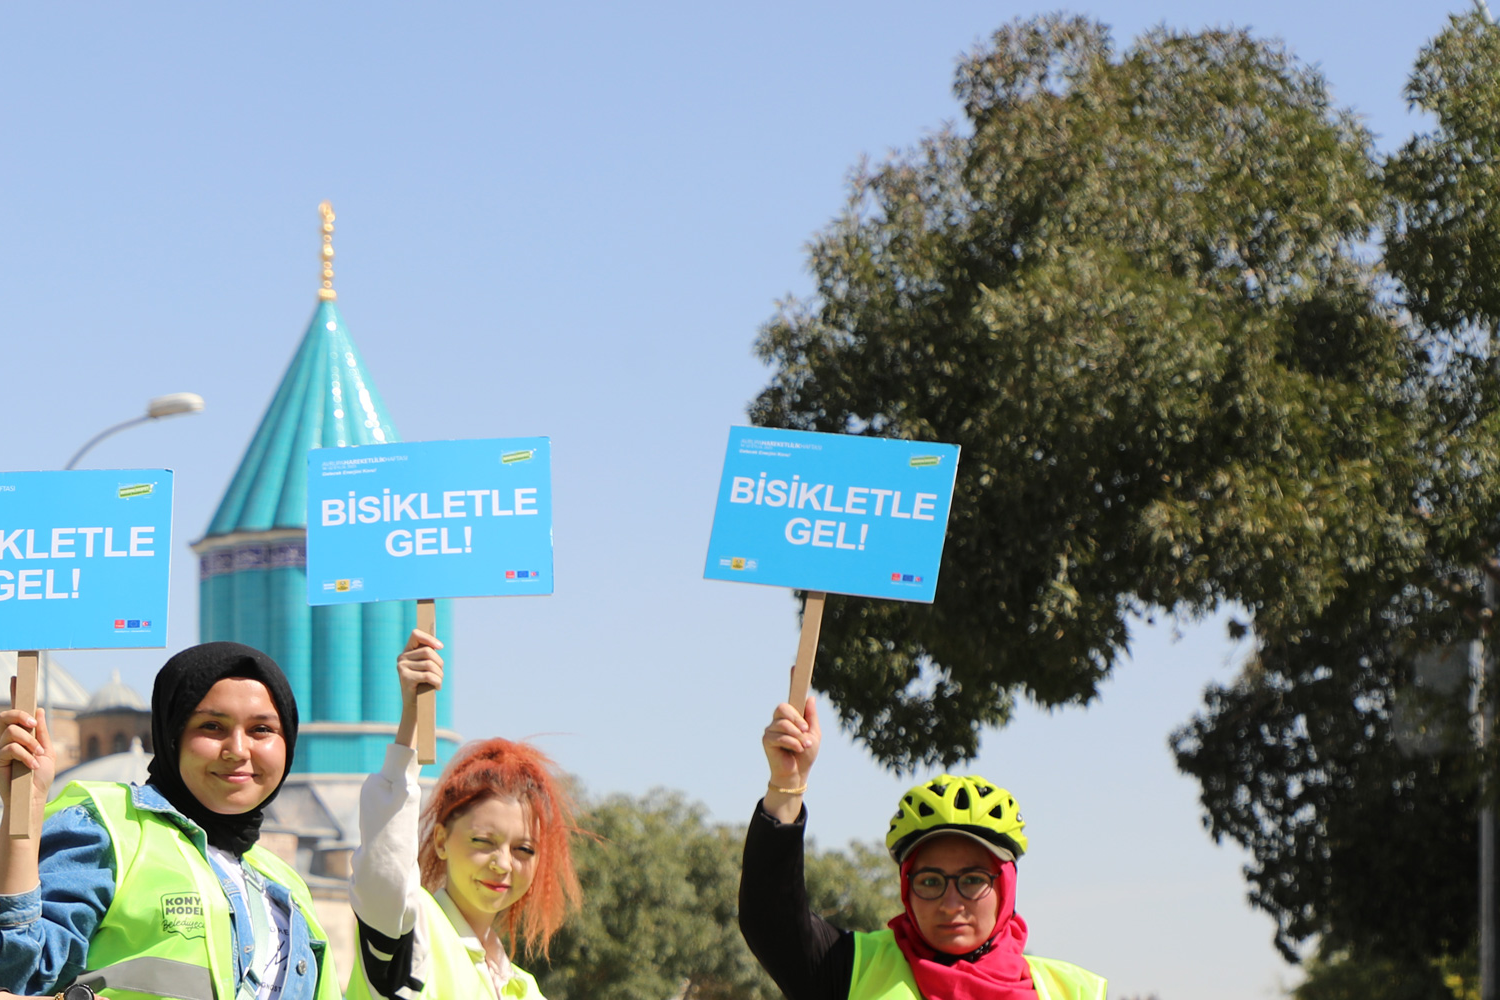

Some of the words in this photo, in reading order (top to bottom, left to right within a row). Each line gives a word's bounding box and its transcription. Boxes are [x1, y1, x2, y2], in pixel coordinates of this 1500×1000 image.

[322, 488, 539, 526] BİSİKLETLE
[730, 472, 938, 521] BİSİKLETLE
[385, 526, 473, 557] GEL!
[785, 517, 869, 551] GEL!
